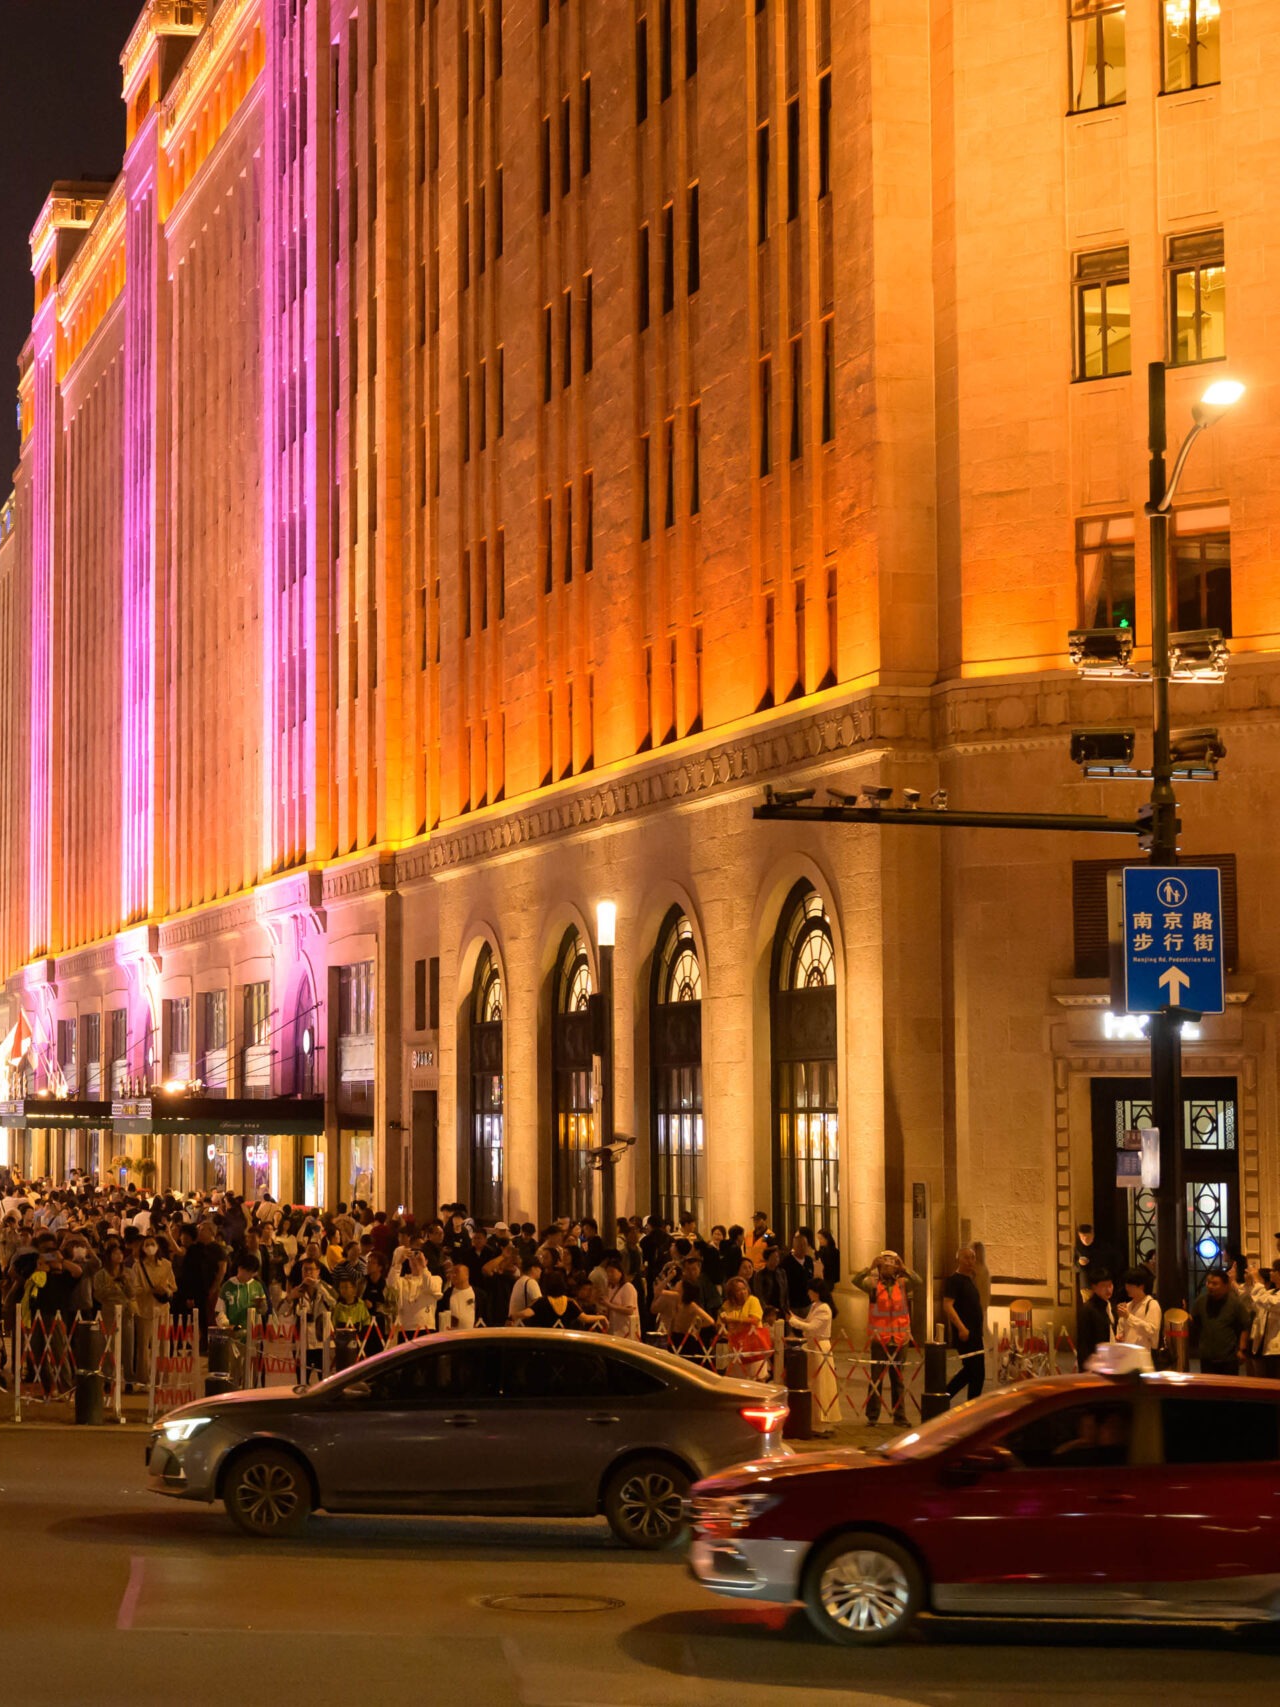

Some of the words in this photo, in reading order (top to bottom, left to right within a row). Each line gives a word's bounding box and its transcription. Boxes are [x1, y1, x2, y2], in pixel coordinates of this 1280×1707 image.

[1132, 911, 1214, 930] 南京路
[1132, 932, 1215, 952] 步行街
